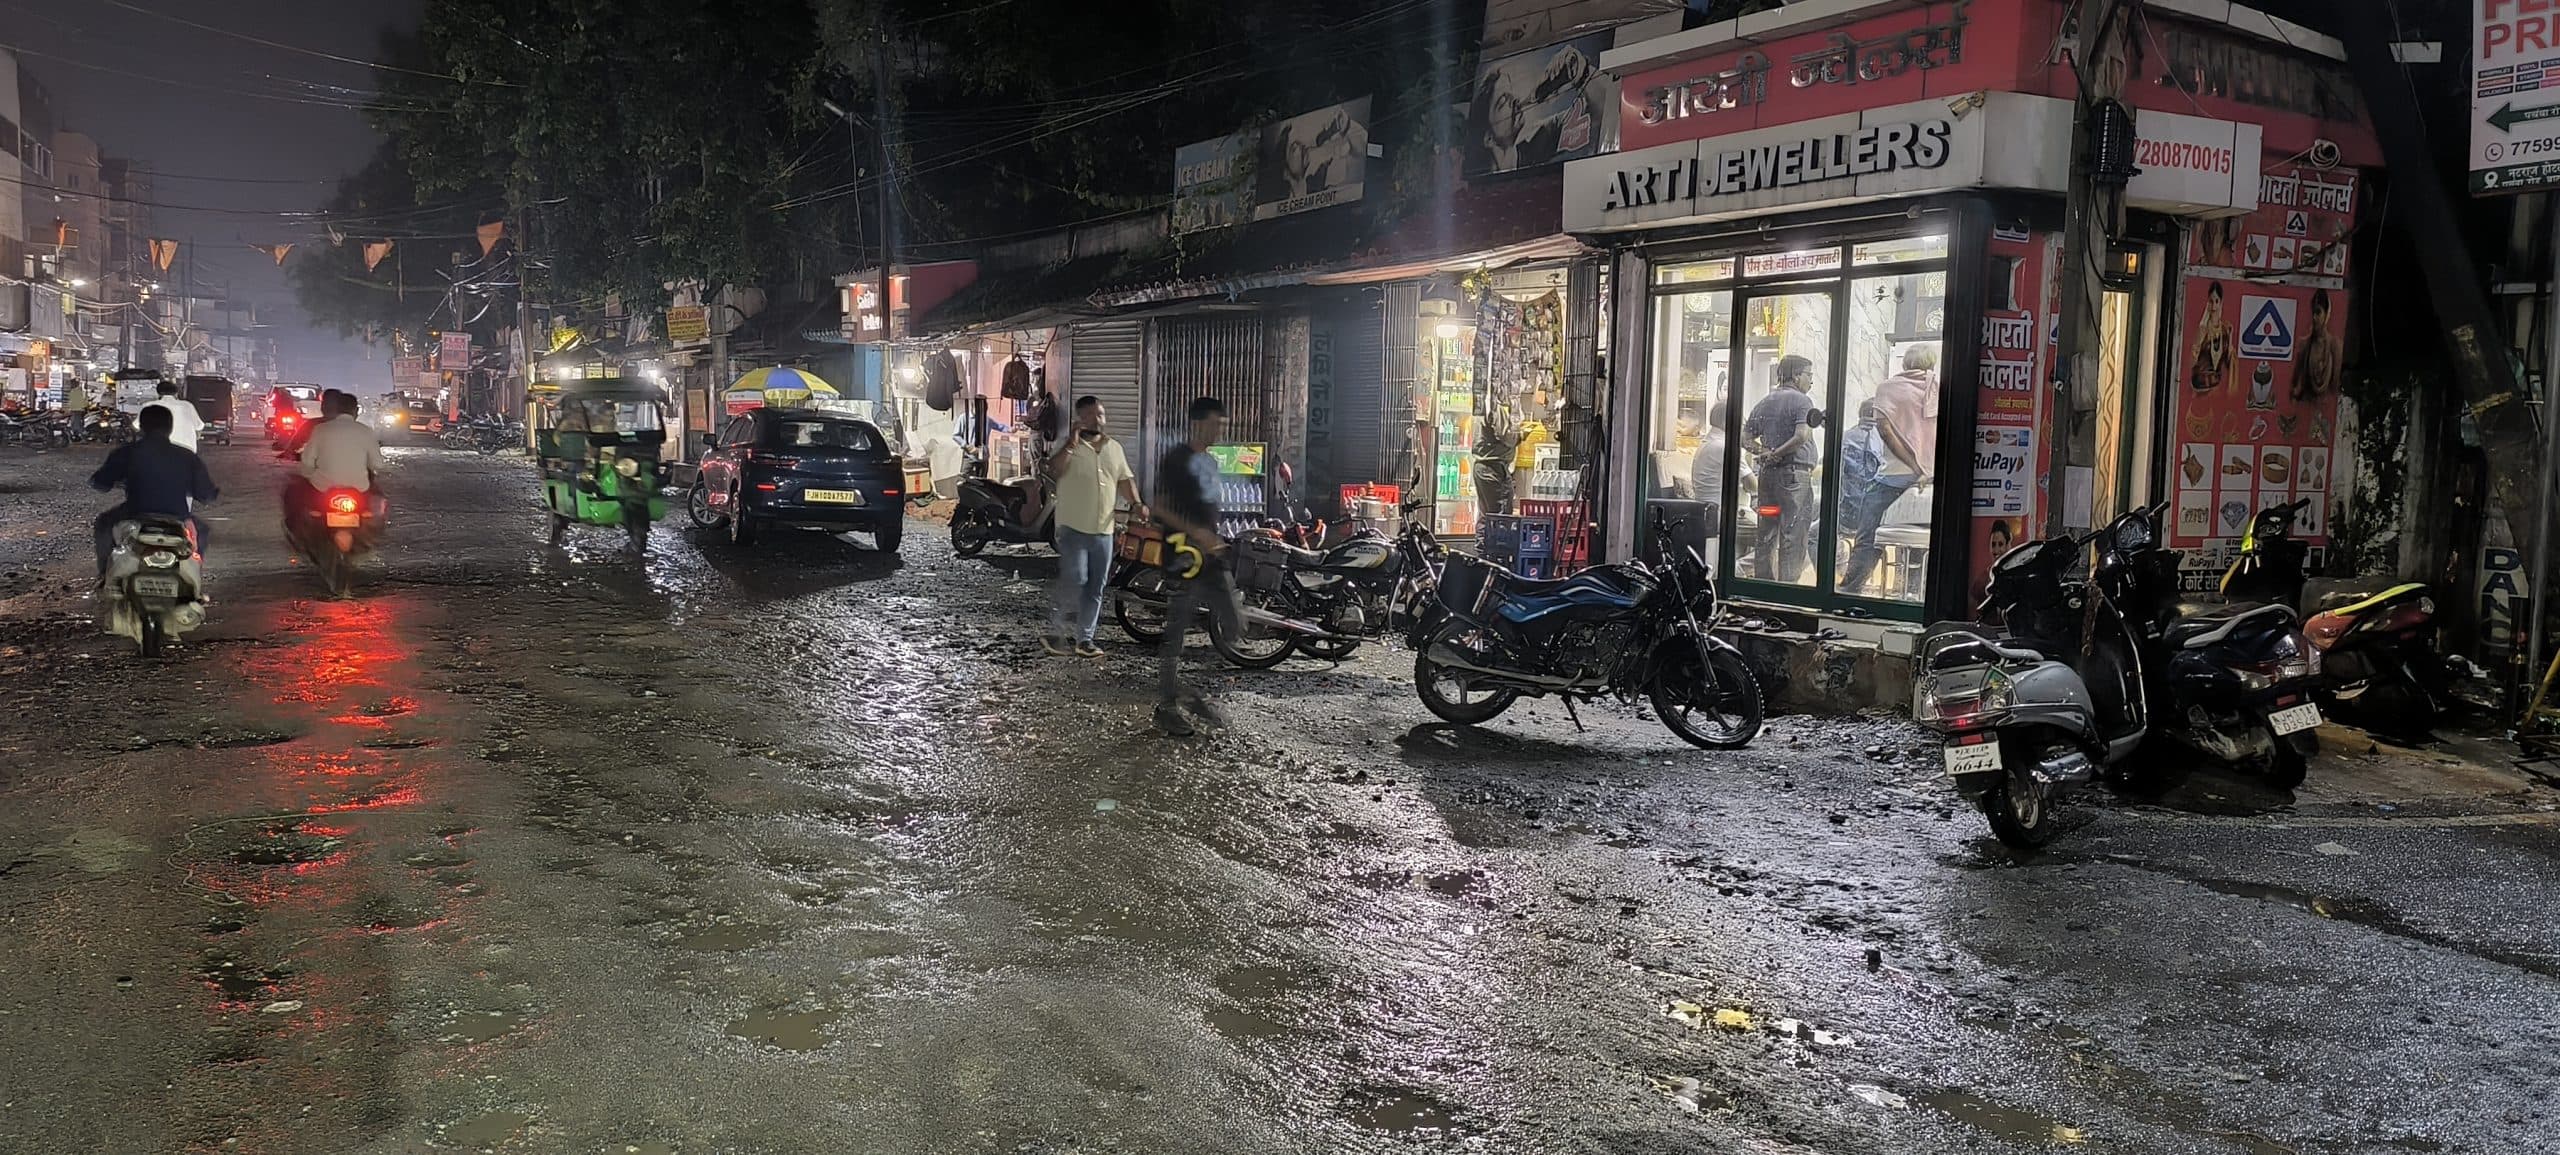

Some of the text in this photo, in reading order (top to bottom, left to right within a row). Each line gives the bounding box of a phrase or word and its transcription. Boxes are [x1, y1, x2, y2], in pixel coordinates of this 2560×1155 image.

[1638, 50, 1773, 126] आरती
[1177, 165, 1193, 189] ICE
[1195, 158, 1226, 184] CREAM
[1602, 119, 1952, 211] ARTI JEWELLERS
[2133, 138, 2231, 174] 7280870015
[1289, 196, 1315, 209] CREAM
[1315, 190, 1338, 206] POINT
[2303, 172, 2354, 213] ज्वेलर्स
[1953, 758, 1994, 772] 6644
